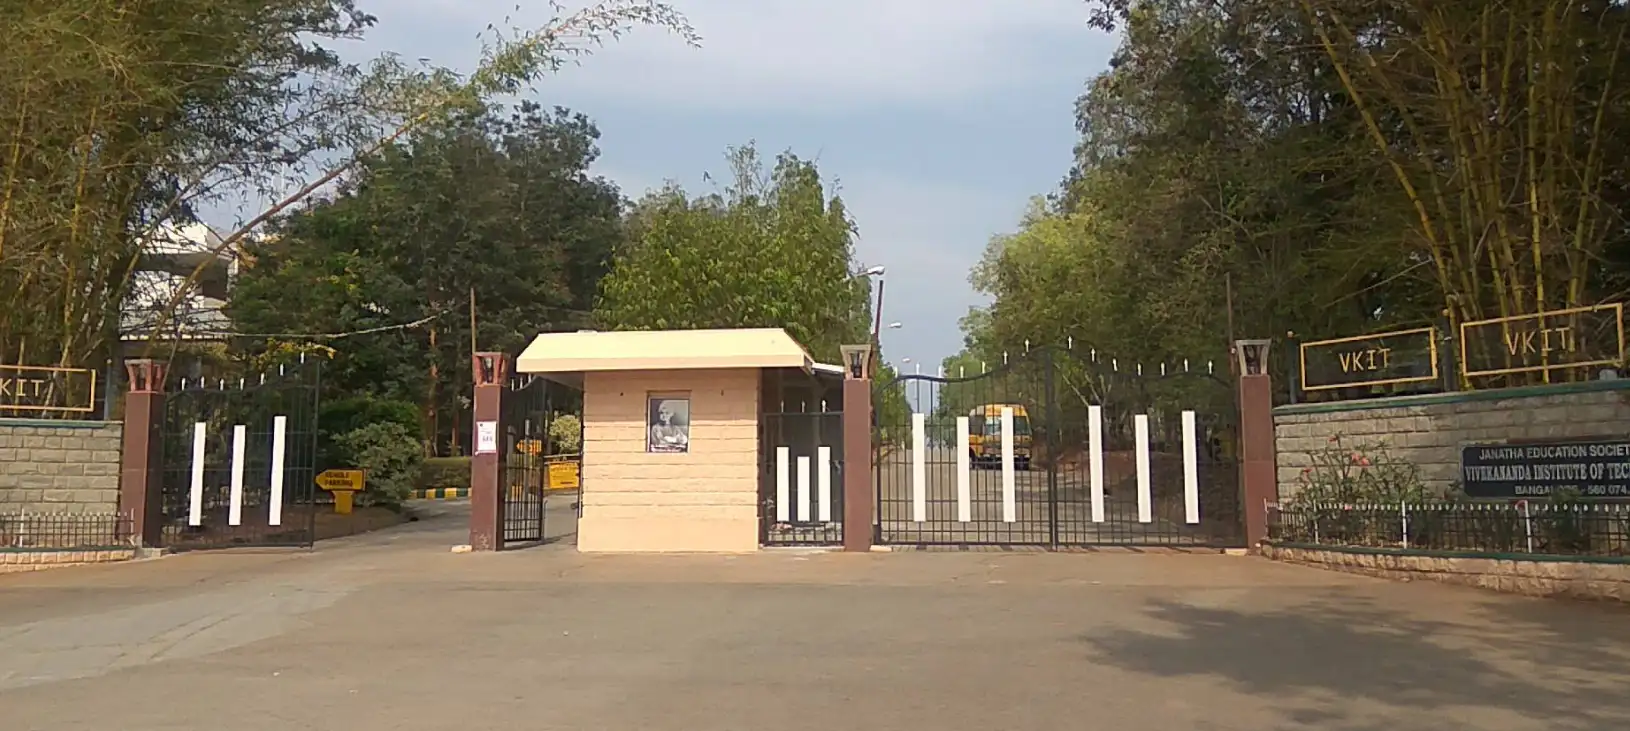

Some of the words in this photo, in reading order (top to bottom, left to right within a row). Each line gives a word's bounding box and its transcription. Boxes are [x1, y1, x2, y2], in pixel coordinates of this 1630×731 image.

[1505, 327, 1570, 355] VKIT
[1339, 348, 1391, 373] VKIT
[1479, 447, 1523, 460] JANATHA
[1526, 445, 1587, 459] EDUCATION
[1465, 465, 1531, 482] VIVEKANANDA
[1533, 463, 1587, 481] INSTITUTE
[1589, 463, 1604, 480] OF
[1606, 462, 1630, 480] TEC
